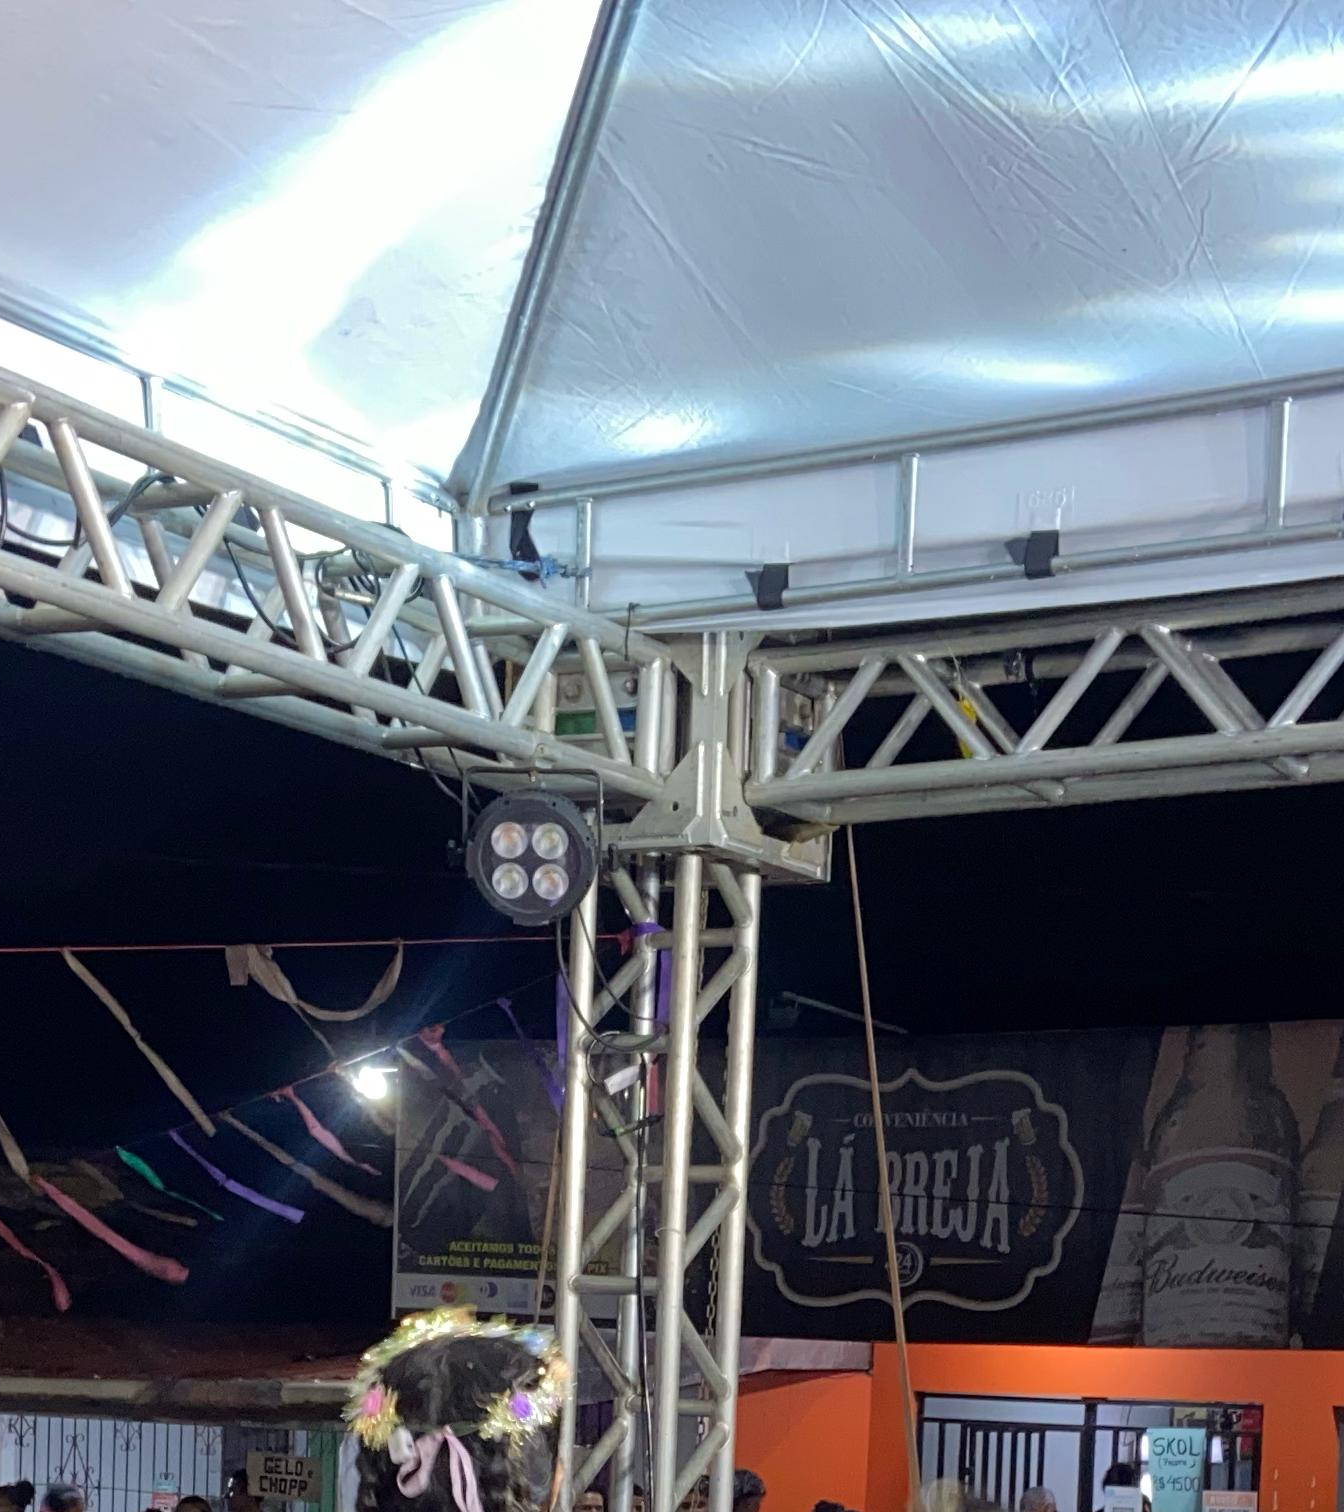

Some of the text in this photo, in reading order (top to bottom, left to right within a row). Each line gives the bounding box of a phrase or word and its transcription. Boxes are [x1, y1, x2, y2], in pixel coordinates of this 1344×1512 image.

[853, 1107, 968, 1128] COVENIÊNCIA
[801, 1133, 1011, 1254] LÁ BREJA
[448, 1241, 514, 1255] ACEITAMOS
[418, 1254, 470, 1268] CARTÕES
[473, 1257, 480, 1268] E
[409, 1285, 436, 1298] VISA
[1152, 1436, 1201, 1457] SKOL
[264, 1456, 304, 1477] GELO
[259, 1475, 308, 1497] CHOPP
